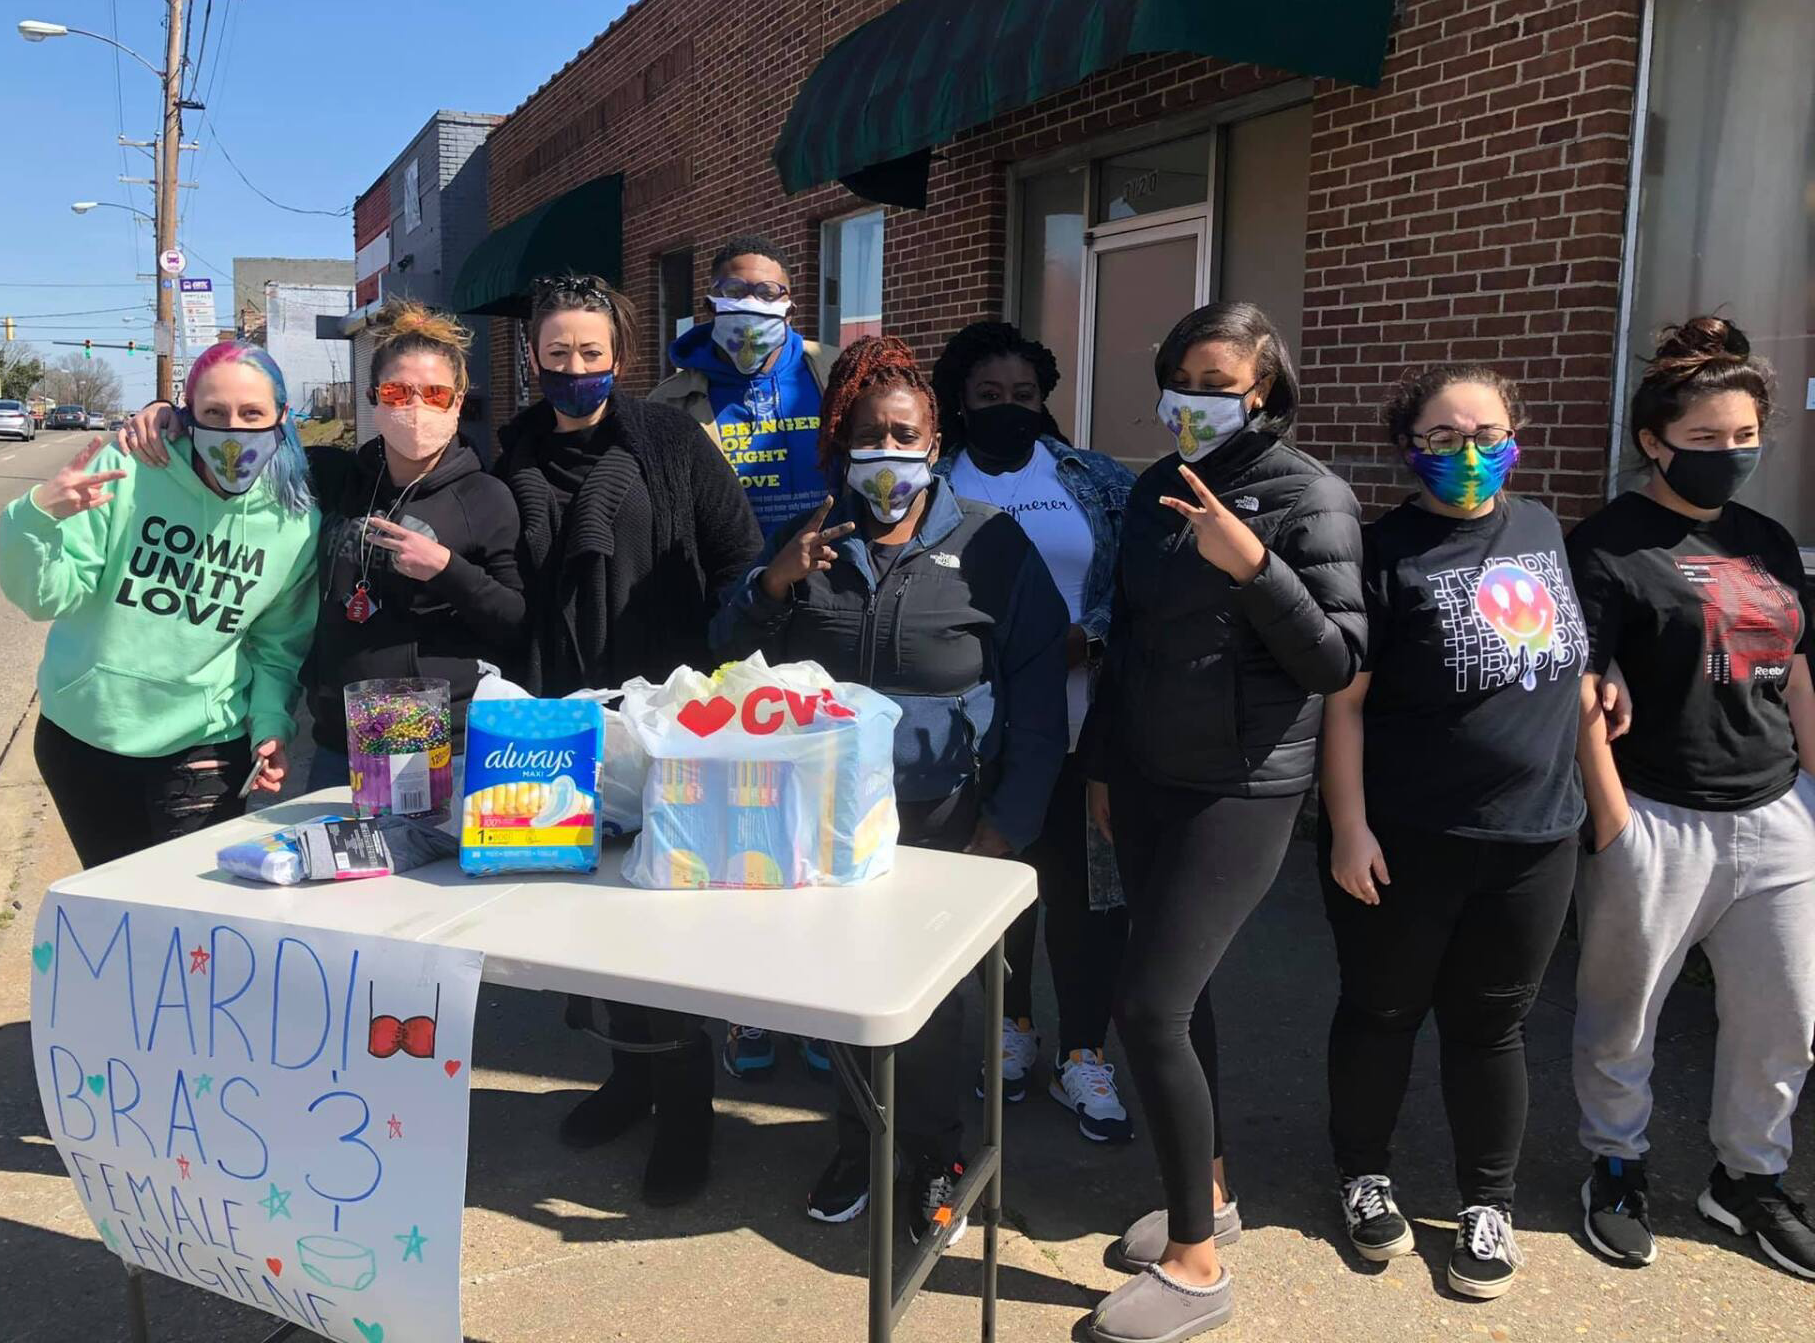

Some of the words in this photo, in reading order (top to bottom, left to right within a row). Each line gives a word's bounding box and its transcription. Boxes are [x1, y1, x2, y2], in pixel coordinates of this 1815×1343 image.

[721, 437, 752, 451] OF
[725, 449, 787, 465] LIGHT
[738, 475, 780, 488] OVE
[141, 515, 265, 577] COMM
[129, 546, 257, 606] UNITY
[115, 577, 244, 634] LOVE
[484, 742, 576, 777] always
[522, 770, 544, 778] MAXI
[51, 905, 359, 1071] MARDI
[50, 1045, 269, 1180] BRAS
[304, 1090, 382, 1203] 3
[71, 1152, 254, 1260] FEMALE
[121, 1220, 349, 1342] HYGIENE
